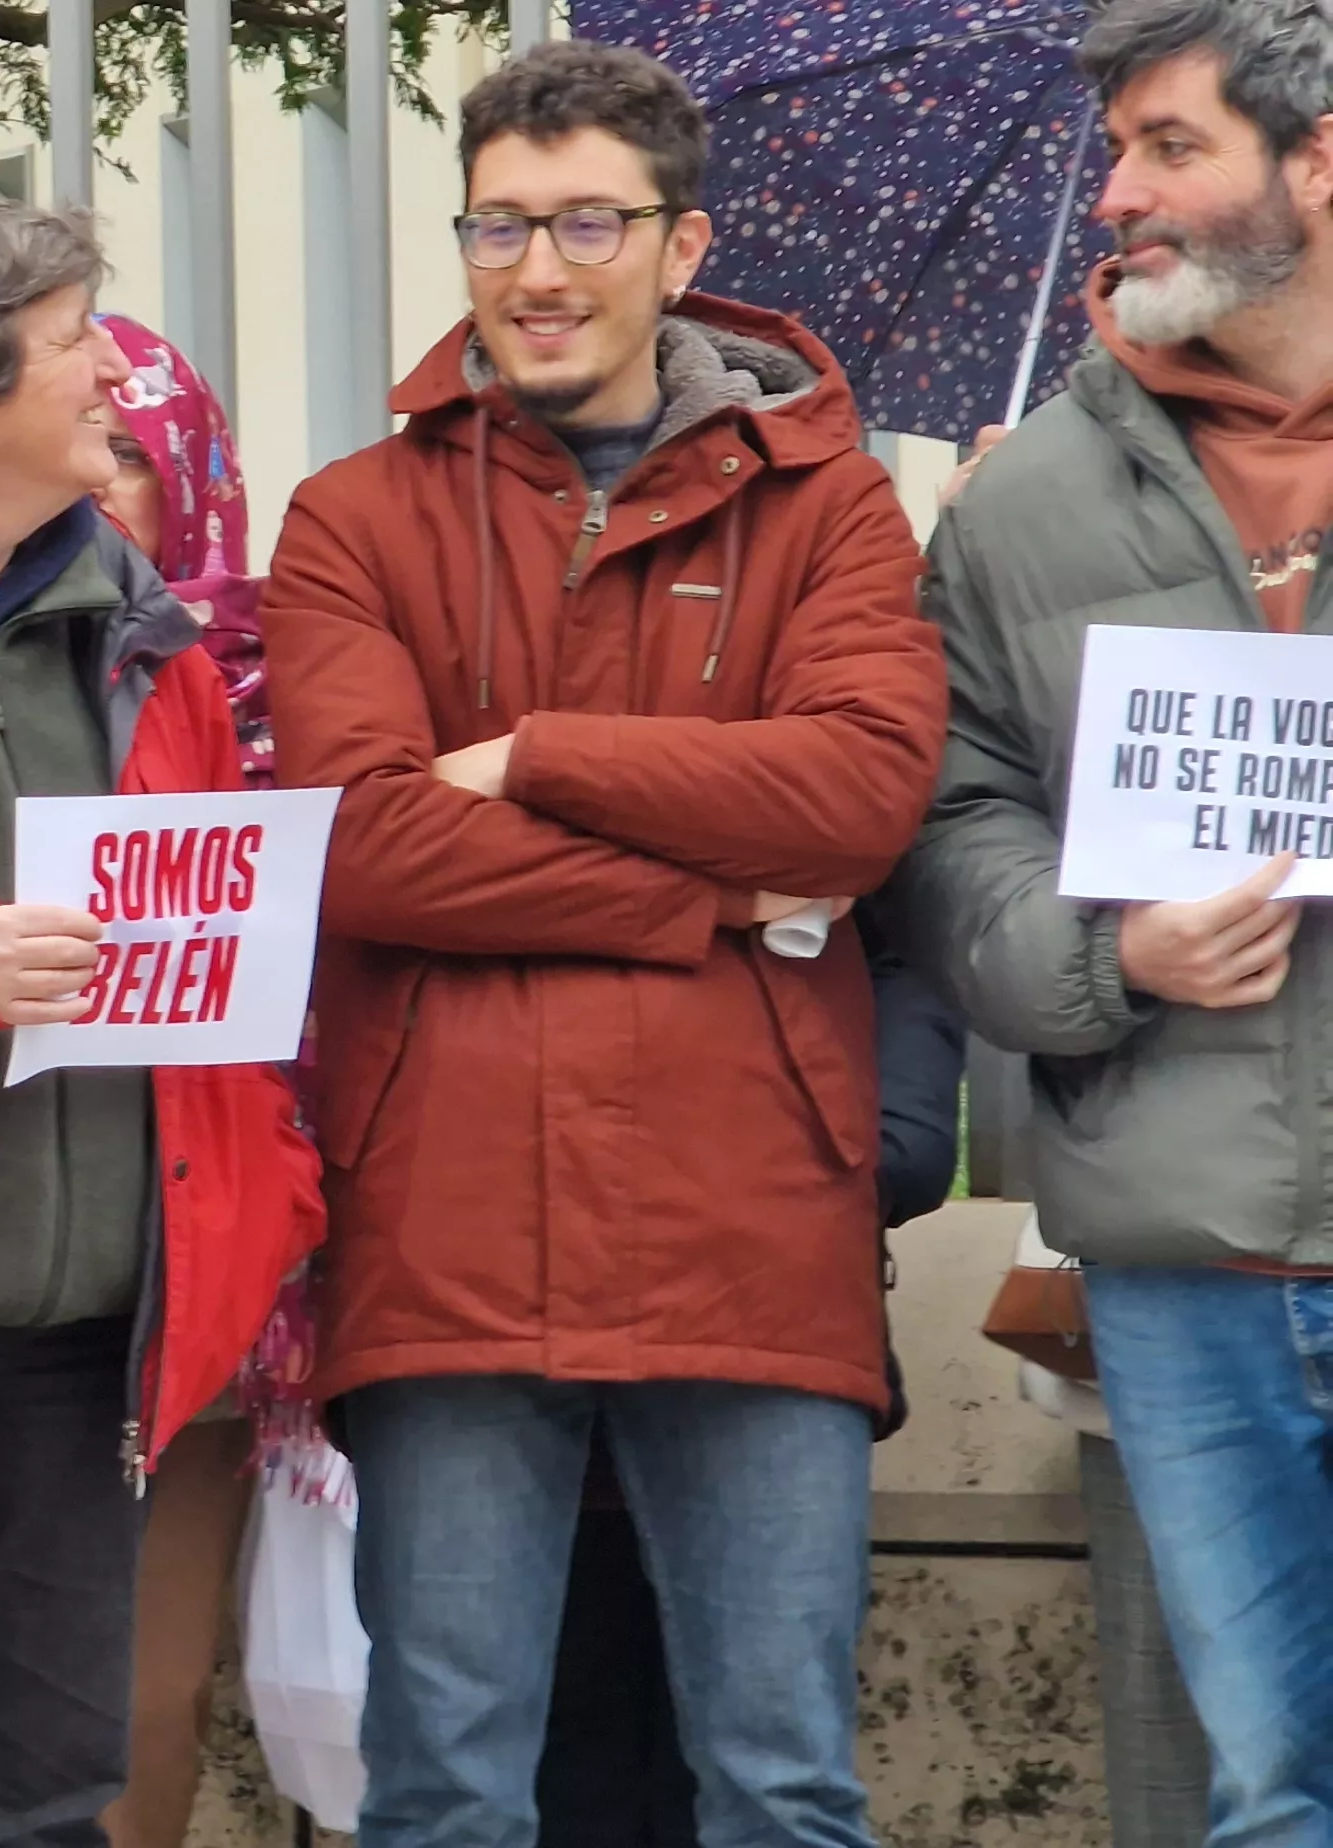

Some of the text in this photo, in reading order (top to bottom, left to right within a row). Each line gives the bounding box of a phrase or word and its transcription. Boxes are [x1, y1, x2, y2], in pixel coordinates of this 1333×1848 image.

[1127, 688, 1196, 736] QUE
[1211, 694, 1253, 741] LA
[1112, 743, 1159, 790] NO
[1176, 748, 1221, 793] SE
[1192, 804, 1229, 851] EL
[88, 824, 263, 924] SOMOS
[69, 920, 240, 1025] BELÉN
